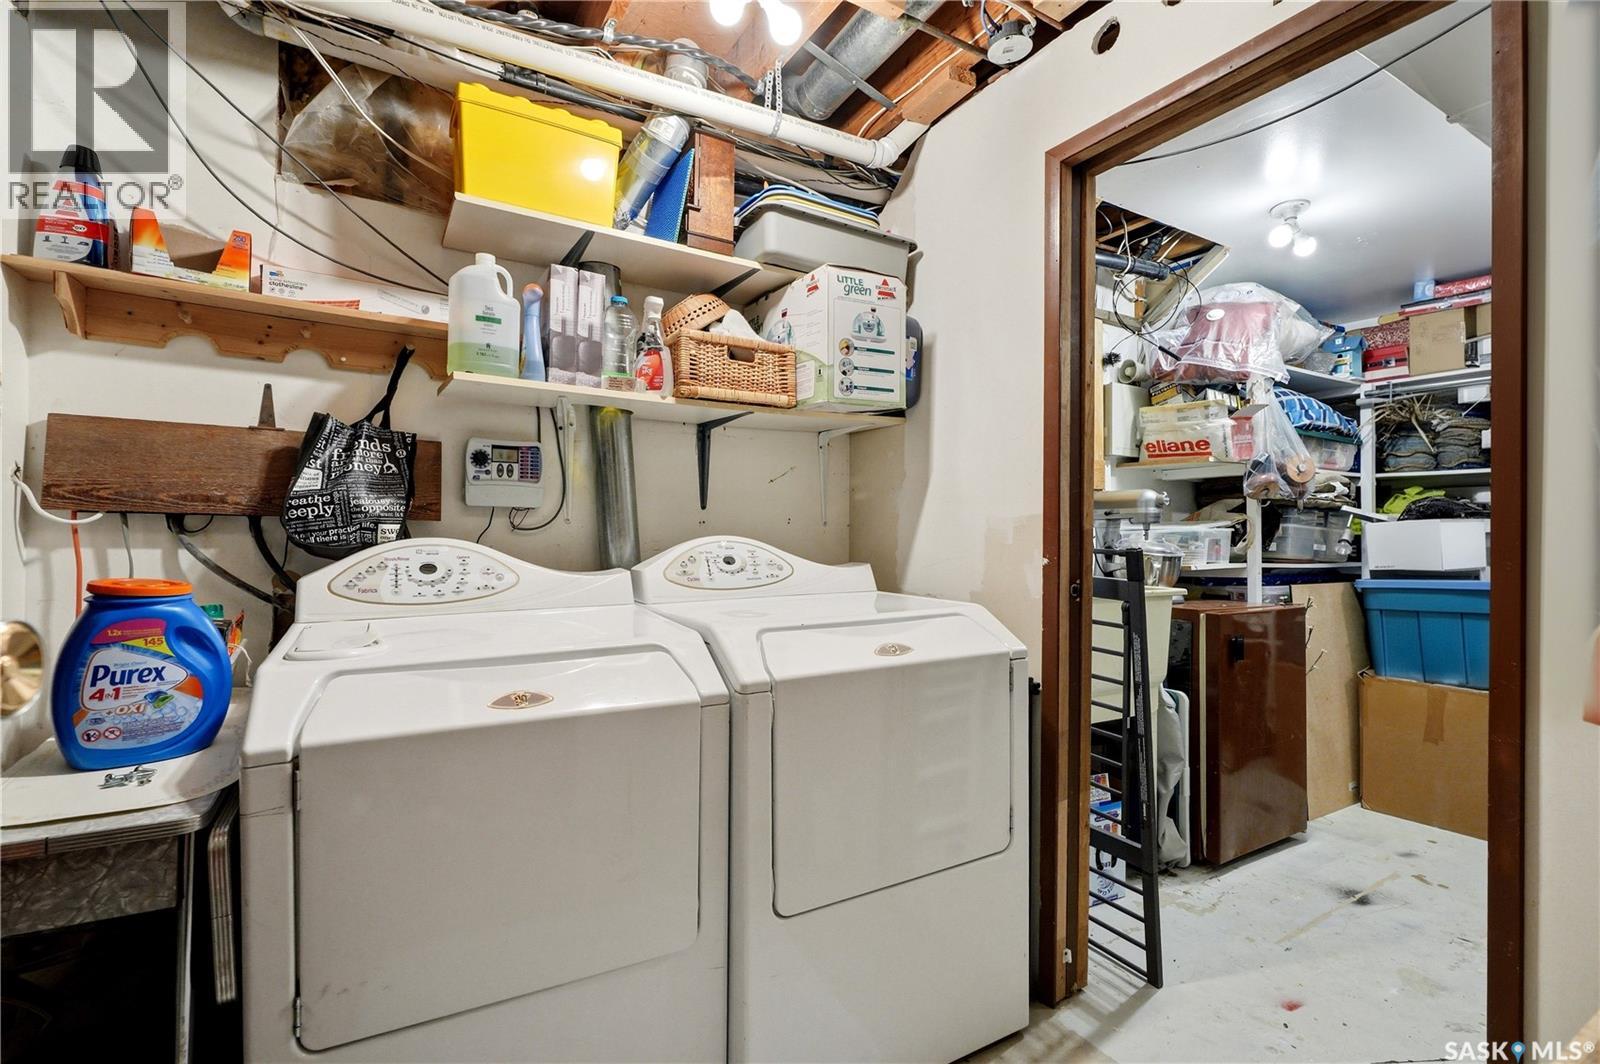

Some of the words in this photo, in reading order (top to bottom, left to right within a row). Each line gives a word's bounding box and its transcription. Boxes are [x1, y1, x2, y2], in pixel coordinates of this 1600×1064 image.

[268, 281, 304, 291] clothesline
[837, 274, 864, 287] LITTLE
[843, 284, 872, 296] green
[1145, 439, 1211, 453] eliane
[286, 502, 335, 519] eeply
[361, 502, 406, 514] opposite
[143, 637, 164, 647] 145
[89, 665, 167, 688] Purex
